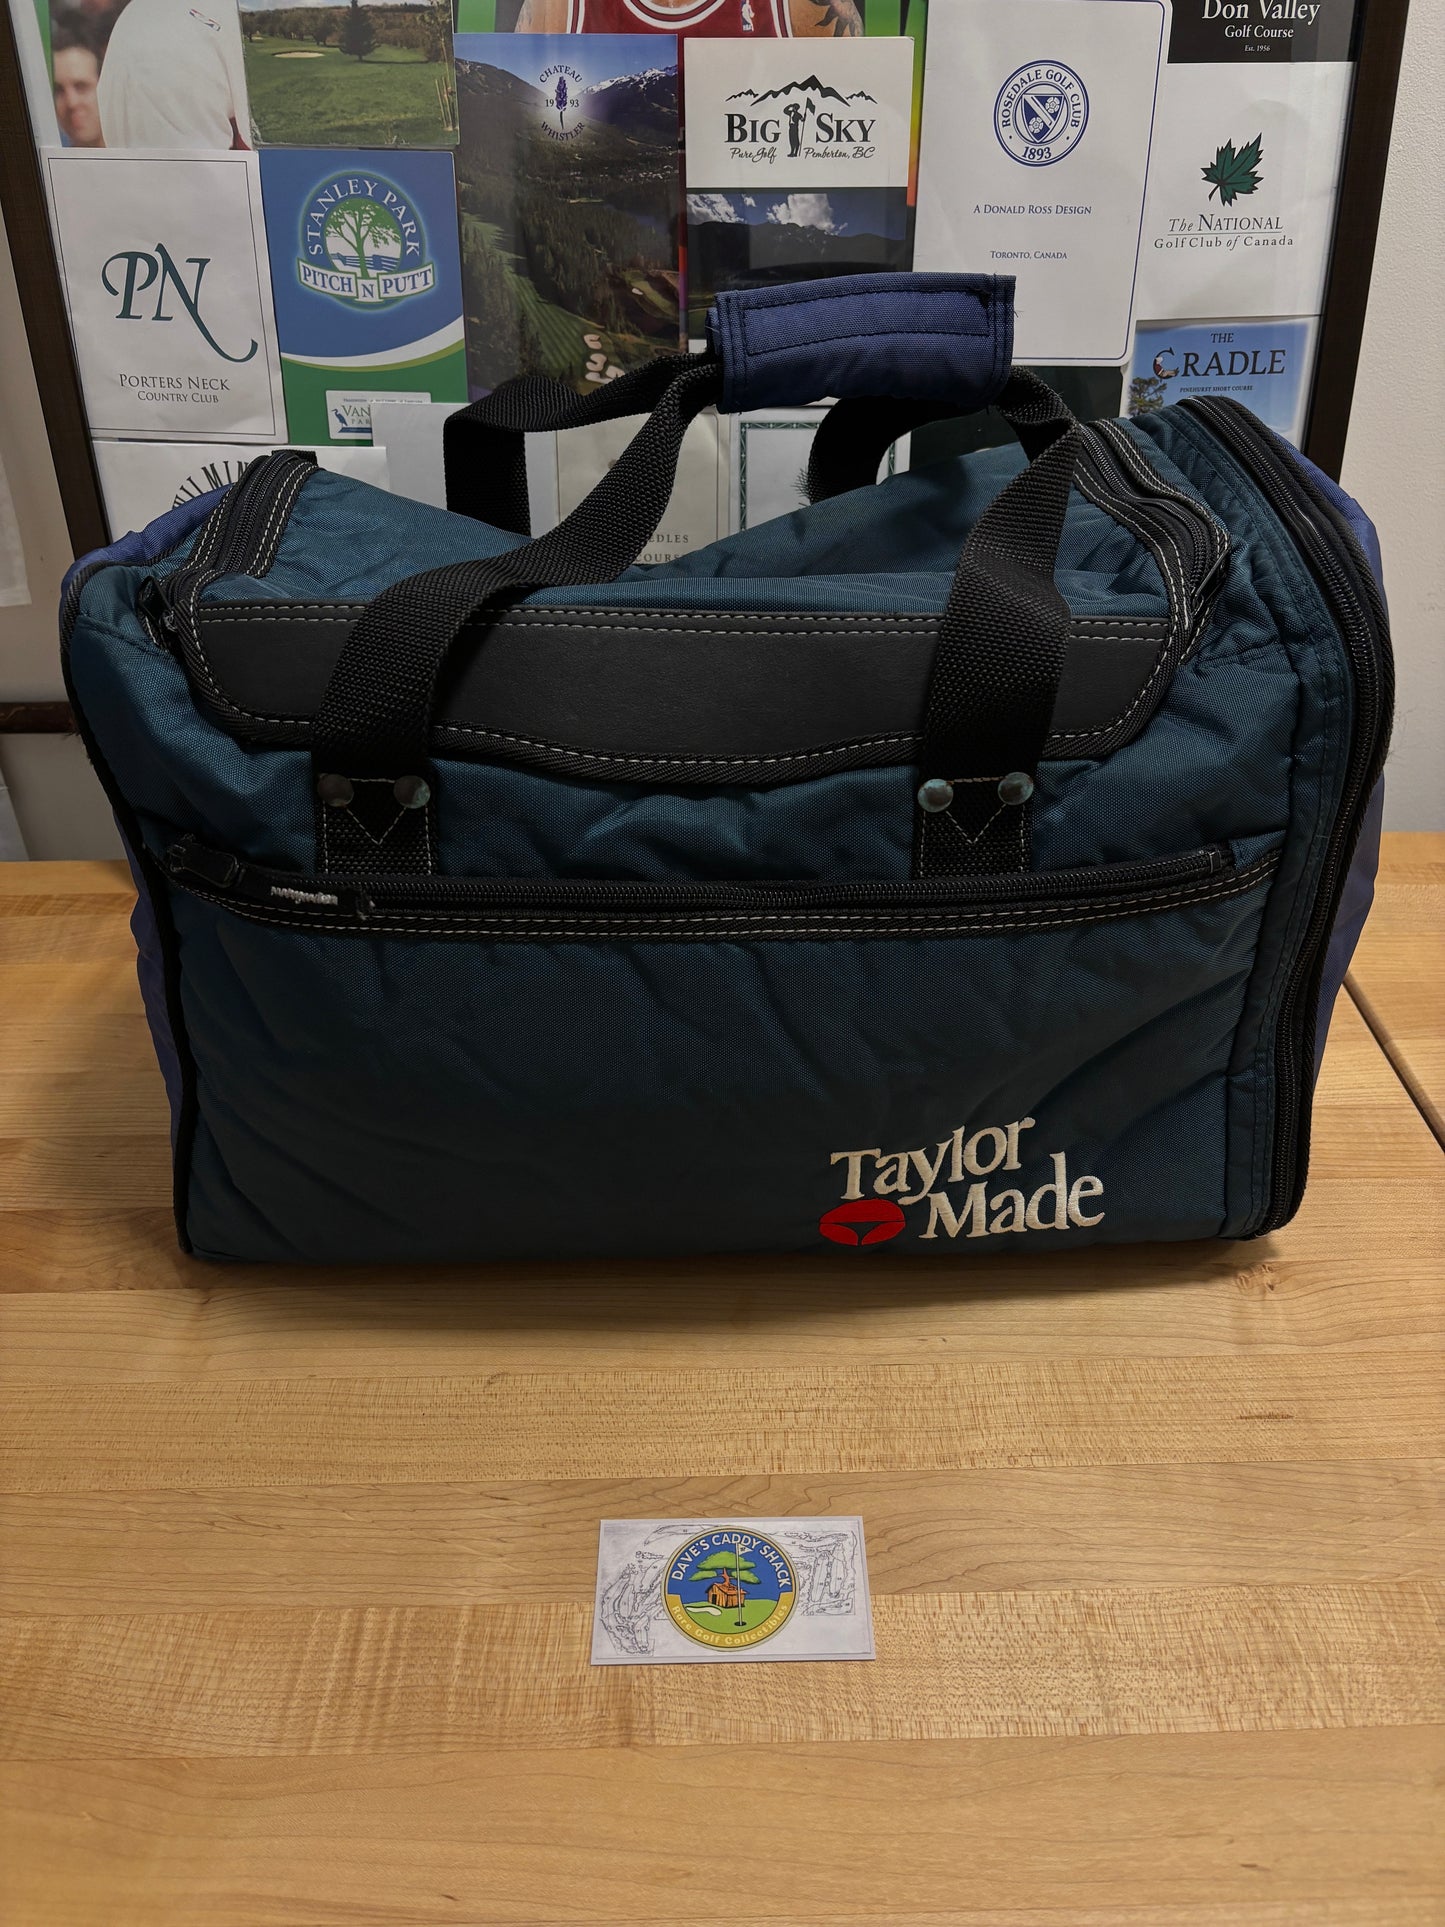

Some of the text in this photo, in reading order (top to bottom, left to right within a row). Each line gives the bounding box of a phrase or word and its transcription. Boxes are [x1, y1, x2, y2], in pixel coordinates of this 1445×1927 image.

[1201, 0, 1320, 25] Don Valley
[1224, 24, 1294, 38] Golf Course
[540, 65, 582, 83] CHATEAU
[545, 99, 579, 107] 19 93
[1001, 69, 1081, 128] ROSEDALE GOLF CLUB
[541, 121, 585, 141] WHISTLER
[730, 146, 876, 164] Pure Golf Pemberton, BC
[1021, 146, 1052, 160] 1893
[307, 178, 420, 256] STANLEY PARK
[973, 204, 1092, 215] A DONALD ROSS DESIGN
[1168, 213, 1283, 232] The NATIONAL
[1154, 235, 1293, 251] Golf Club of Canada
[990, 250, 1067, 260] TORONTO, CANADA
[301, 265, 432, 298] PITCH N PUTT
[101, 243, 258, 363] PN
[1211, 333, 1234, 343] THE
[1153, 347, 1287, 379] CRADLE
[119, 374, 230, 391] PORTERS NECK
[137, 391, 219, 403] COUNTRY CLUB
[830, 1117, 1036, 1205] Taylor
[918, 1151, 1105, 1238] Made
[671, 1533, 791, 1588] DAVE'S CADDY SHACK
[671, 1605, 788, 1645] Rare Golf Collectibles
